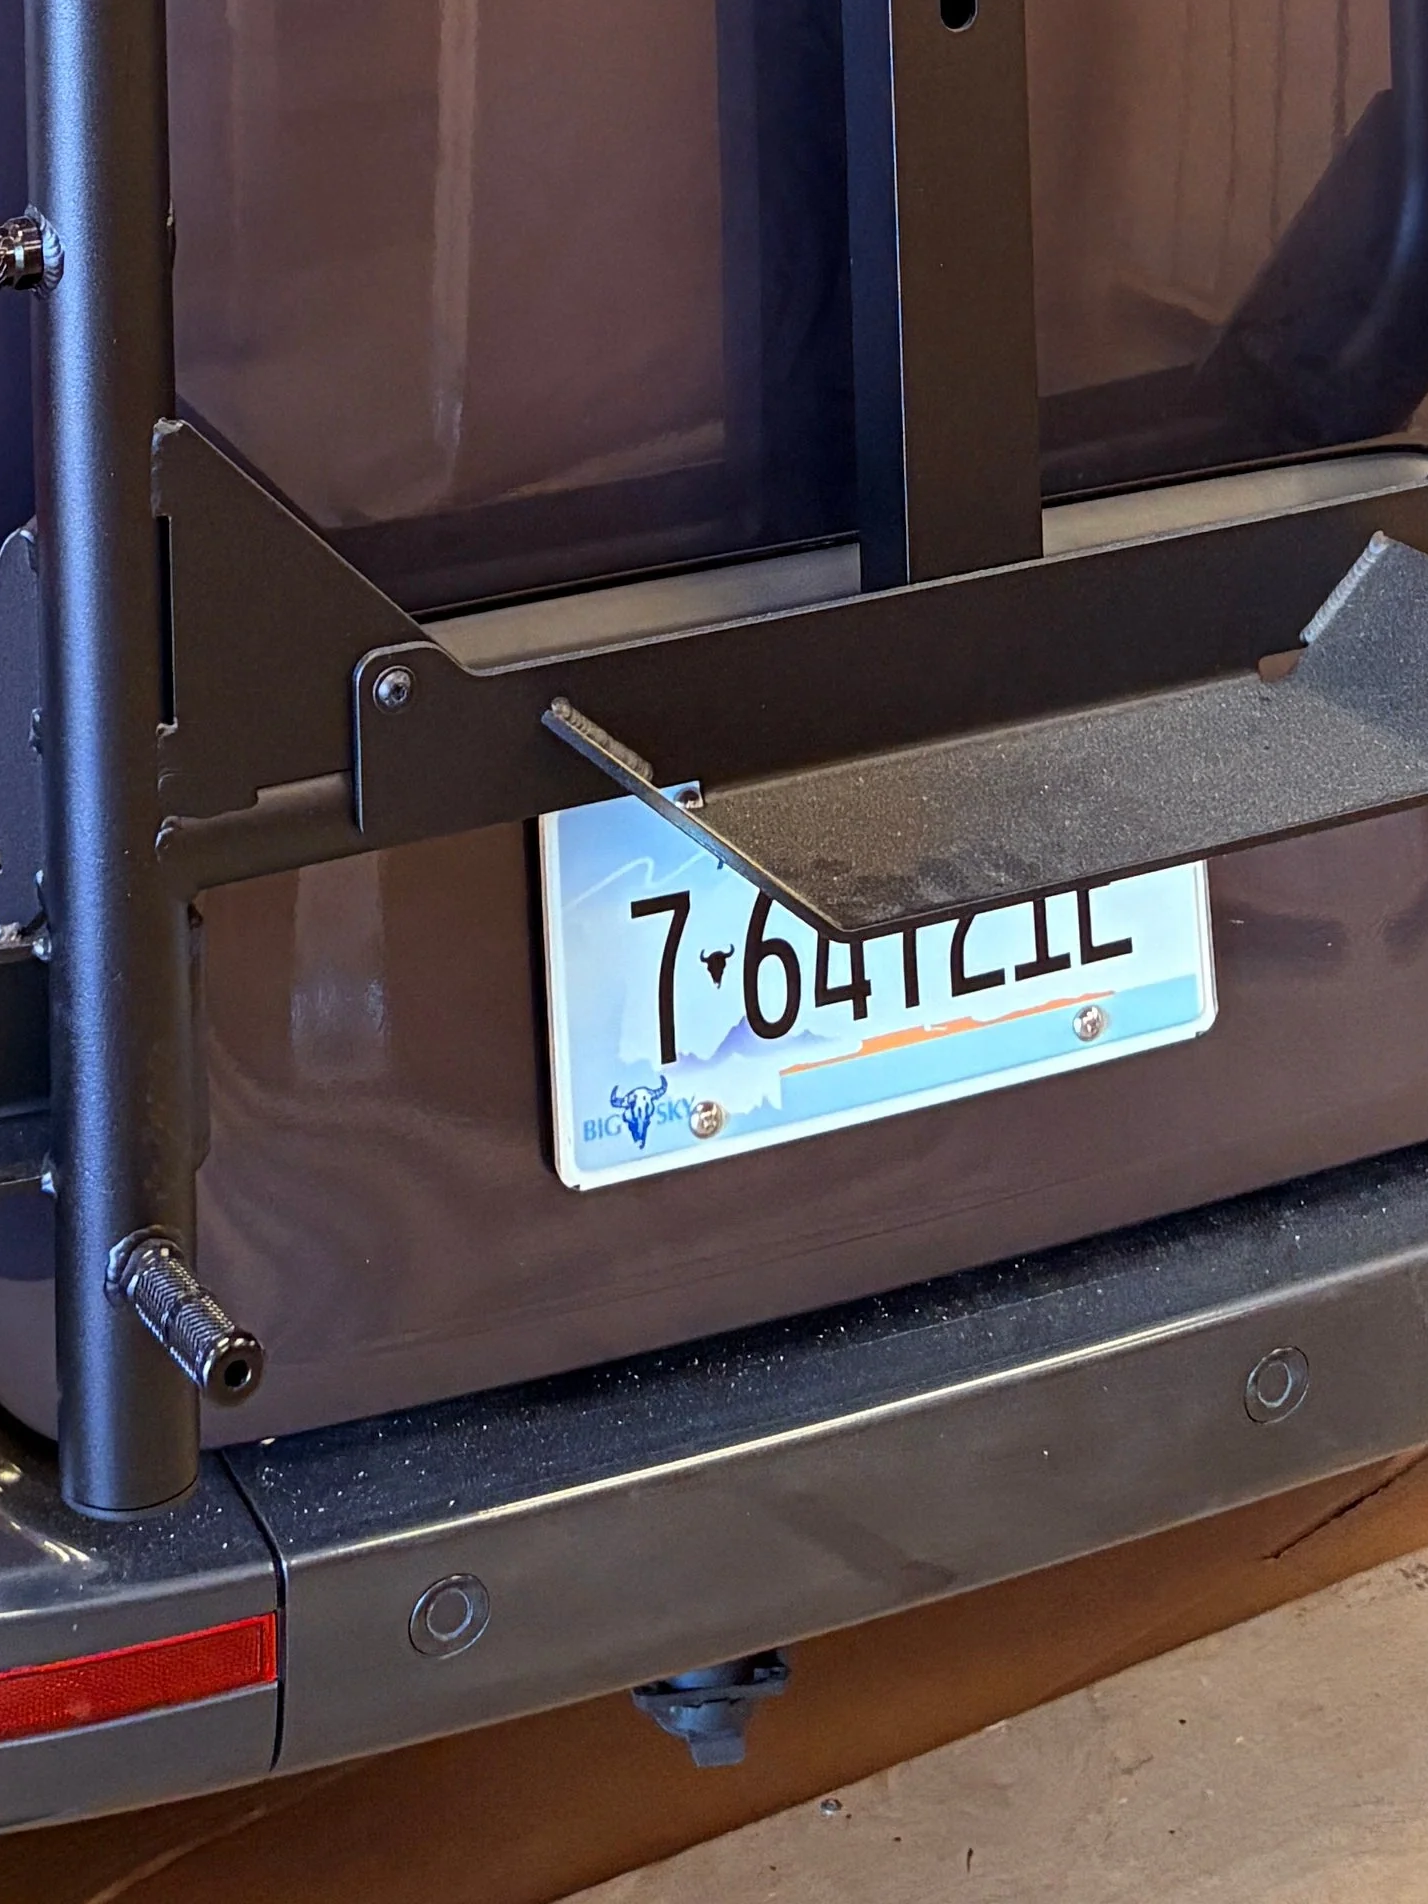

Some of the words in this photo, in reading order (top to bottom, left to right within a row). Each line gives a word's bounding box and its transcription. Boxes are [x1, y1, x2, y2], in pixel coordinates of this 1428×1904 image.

[630, 889, 691, 1065] 7
[582, 1114, 623, 1143] BIG
[656, 1093, 697, 1126] SKY
